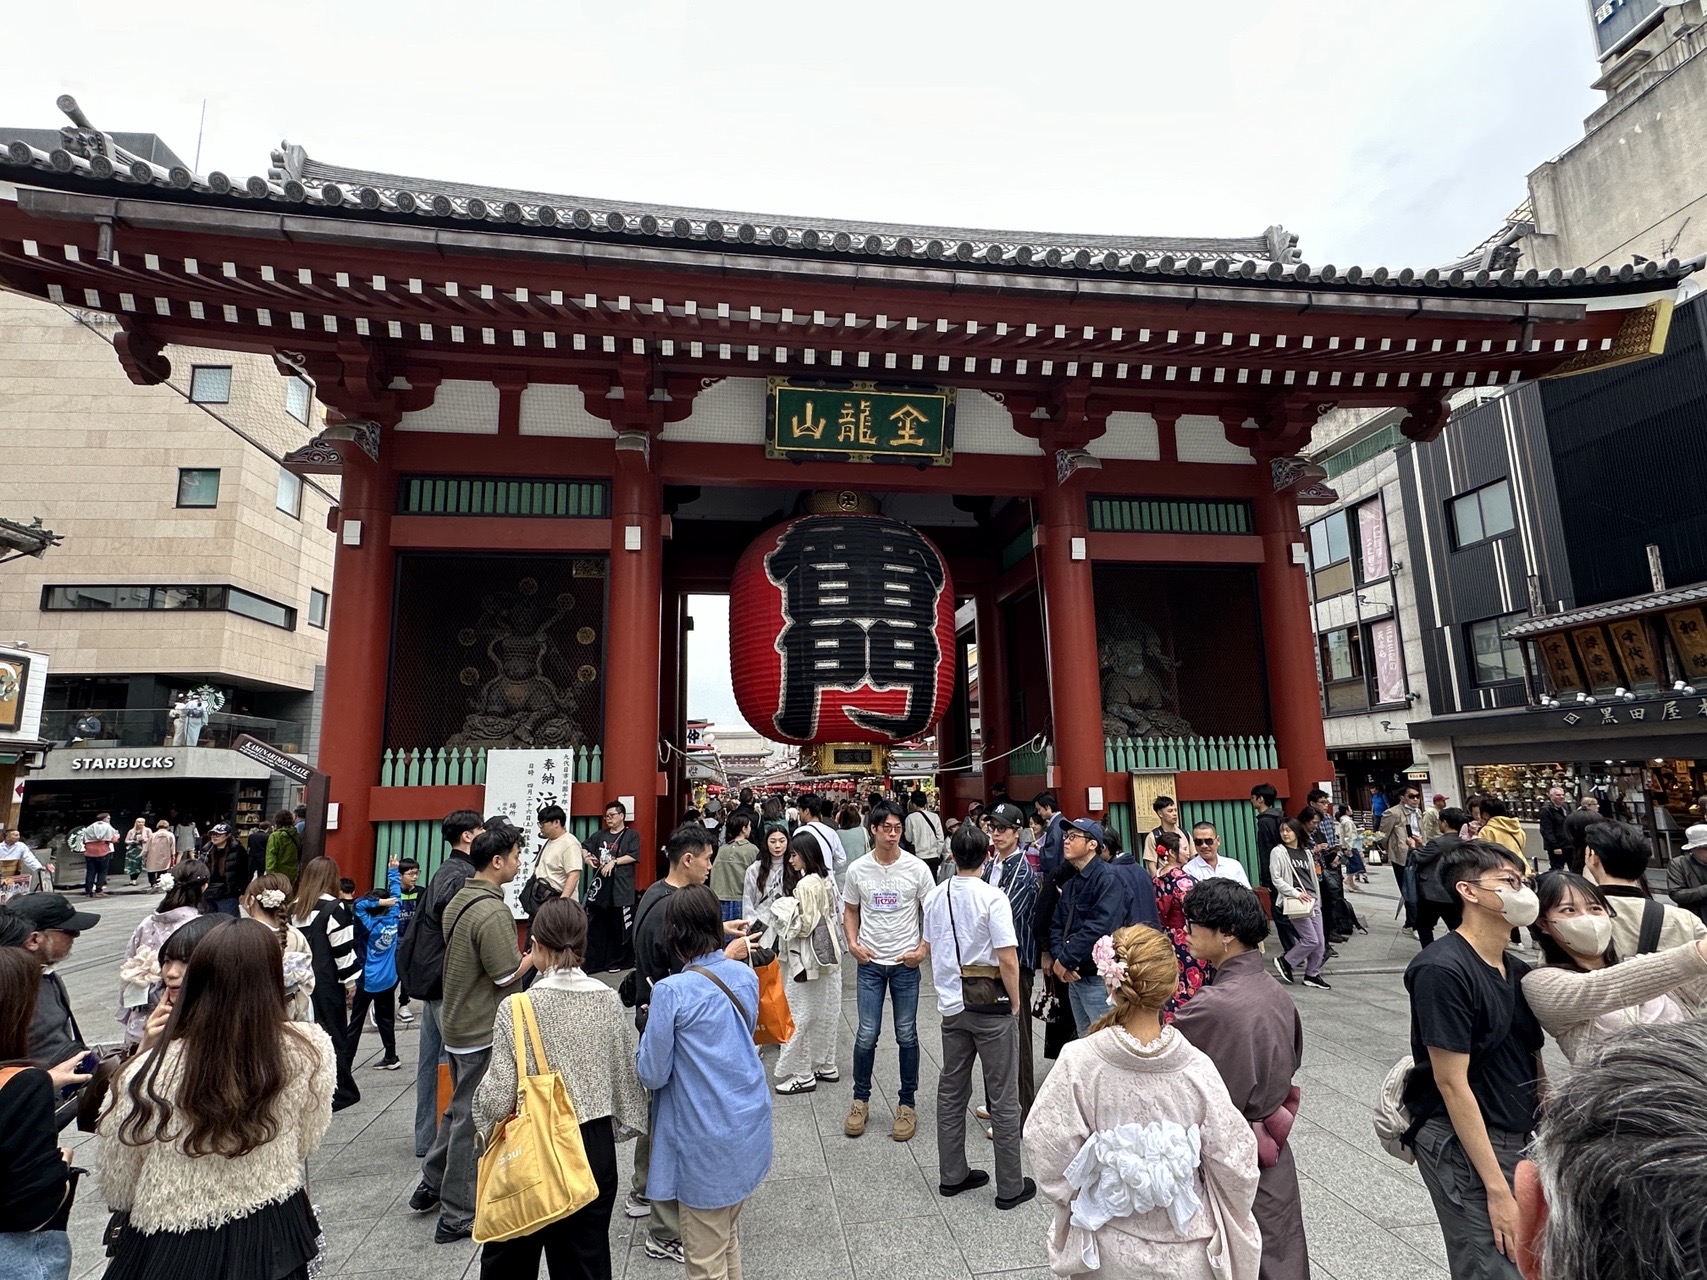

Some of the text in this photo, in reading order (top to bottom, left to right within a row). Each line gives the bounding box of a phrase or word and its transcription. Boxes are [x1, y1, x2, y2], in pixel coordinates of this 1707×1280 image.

[764, 515, 945, 741] 雷門
[72, 757, 174, 770] STARBUCKS
[246, 741, 292, 767] KAMINARIMON
[291, 763, 310, 776] GATE
[527, 763, 534, 775] 日時
[541, 758, 556, 785] 奉納
[880, 879, 910, 890] SERIES
